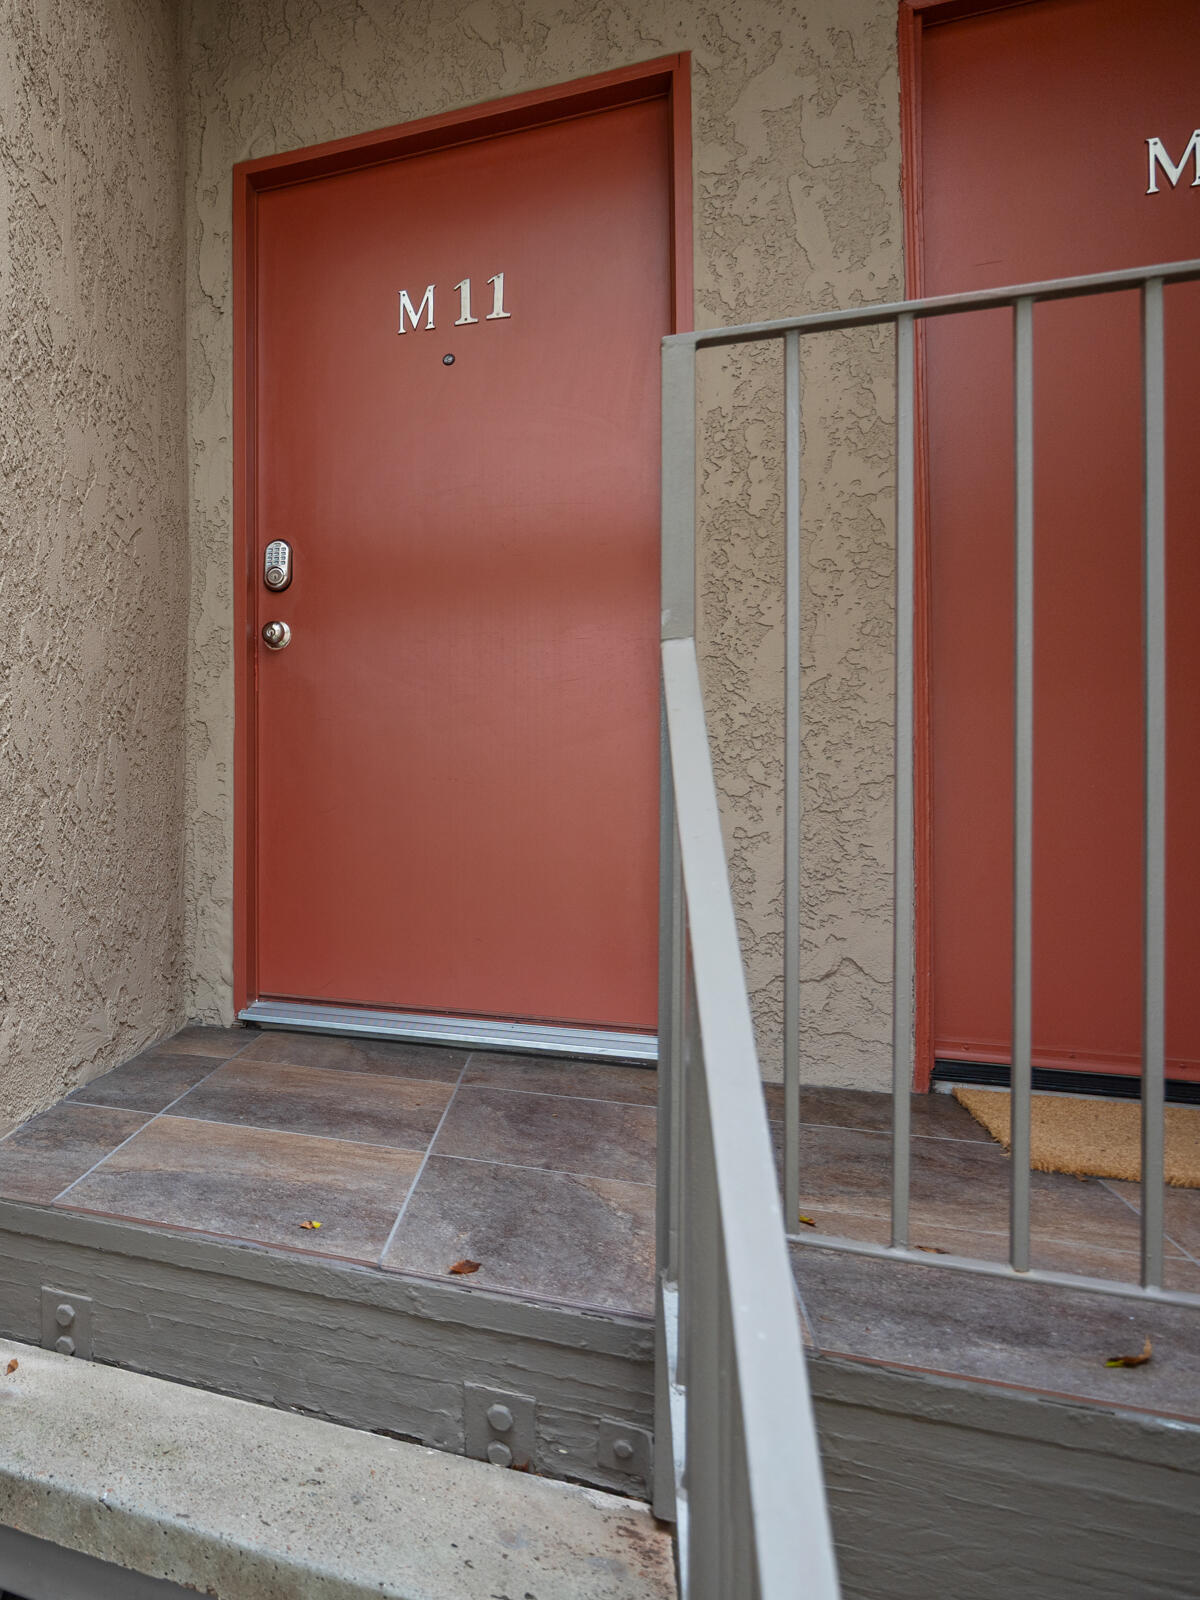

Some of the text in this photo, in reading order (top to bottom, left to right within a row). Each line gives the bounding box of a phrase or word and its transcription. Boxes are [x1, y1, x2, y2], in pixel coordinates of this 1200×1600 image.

[1145, 128, 1200, 194] M
[397, 272, 511, 334] M 11
